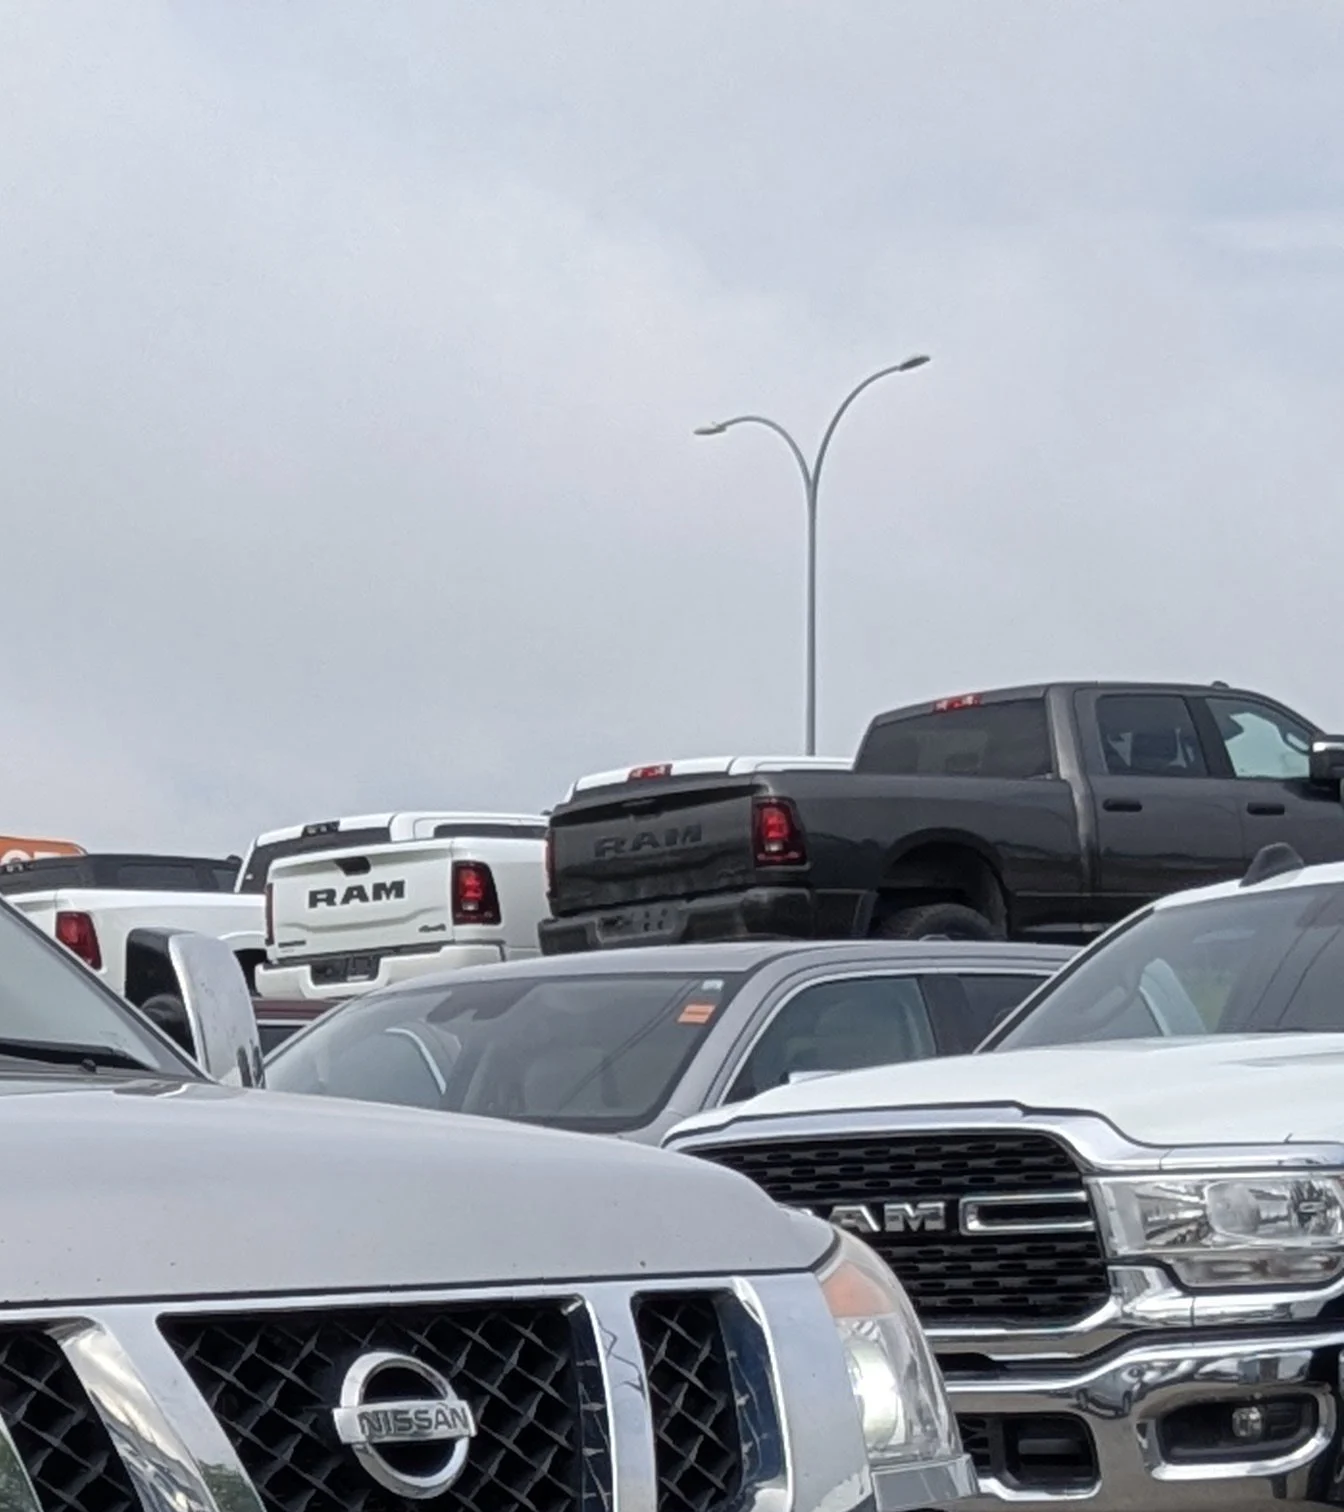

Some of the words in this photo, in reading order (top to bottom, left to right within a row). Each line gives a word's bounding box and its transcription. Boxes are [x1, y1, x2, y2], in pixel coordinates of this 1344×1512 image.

[594, 824, 703, 858] RAM
[308, 880, 406, 909] RAM
[806, 1202, 946, 1233] AM
[357, 1406, 470, 1438] NISSAN
